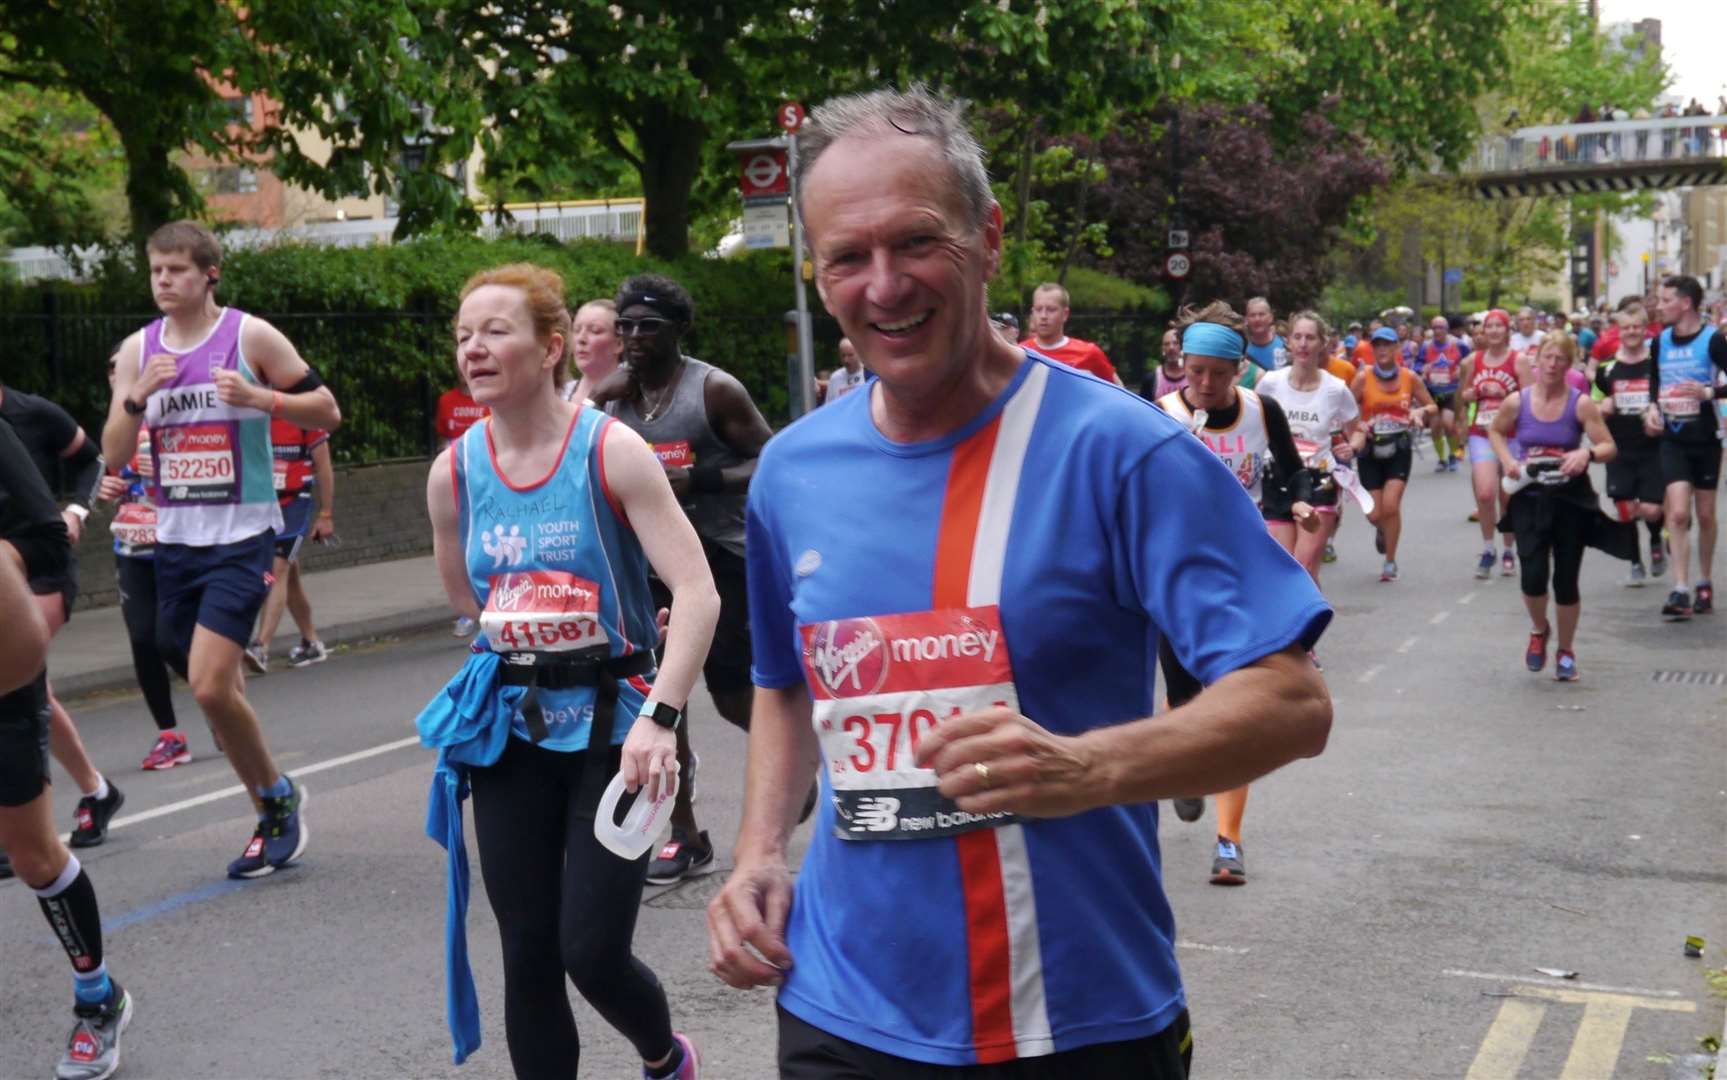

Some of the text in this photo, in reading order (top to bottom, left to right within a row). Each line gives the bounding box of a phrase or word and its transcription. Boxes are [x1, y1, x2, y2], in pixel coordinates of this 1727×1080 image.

[784, 105, 798, 127] S
[1170, 259, 1187, 271] 20
[160, 390, 217, 418] JAMIE
[188, 432, 226, 447] money
[168, 457, 231, 480] 52250
[482, 494, 567, 520] RACHAEL
[537, 521, 580, 535] YOUTH
[538, 535, 577, 549] SPORT
[538, 549, 577, 561] TRUST
[496, 573, 593, 611] Virgin money
[814, 620, 999, 690] Virgin money
[900, 816, 935, 831] new
